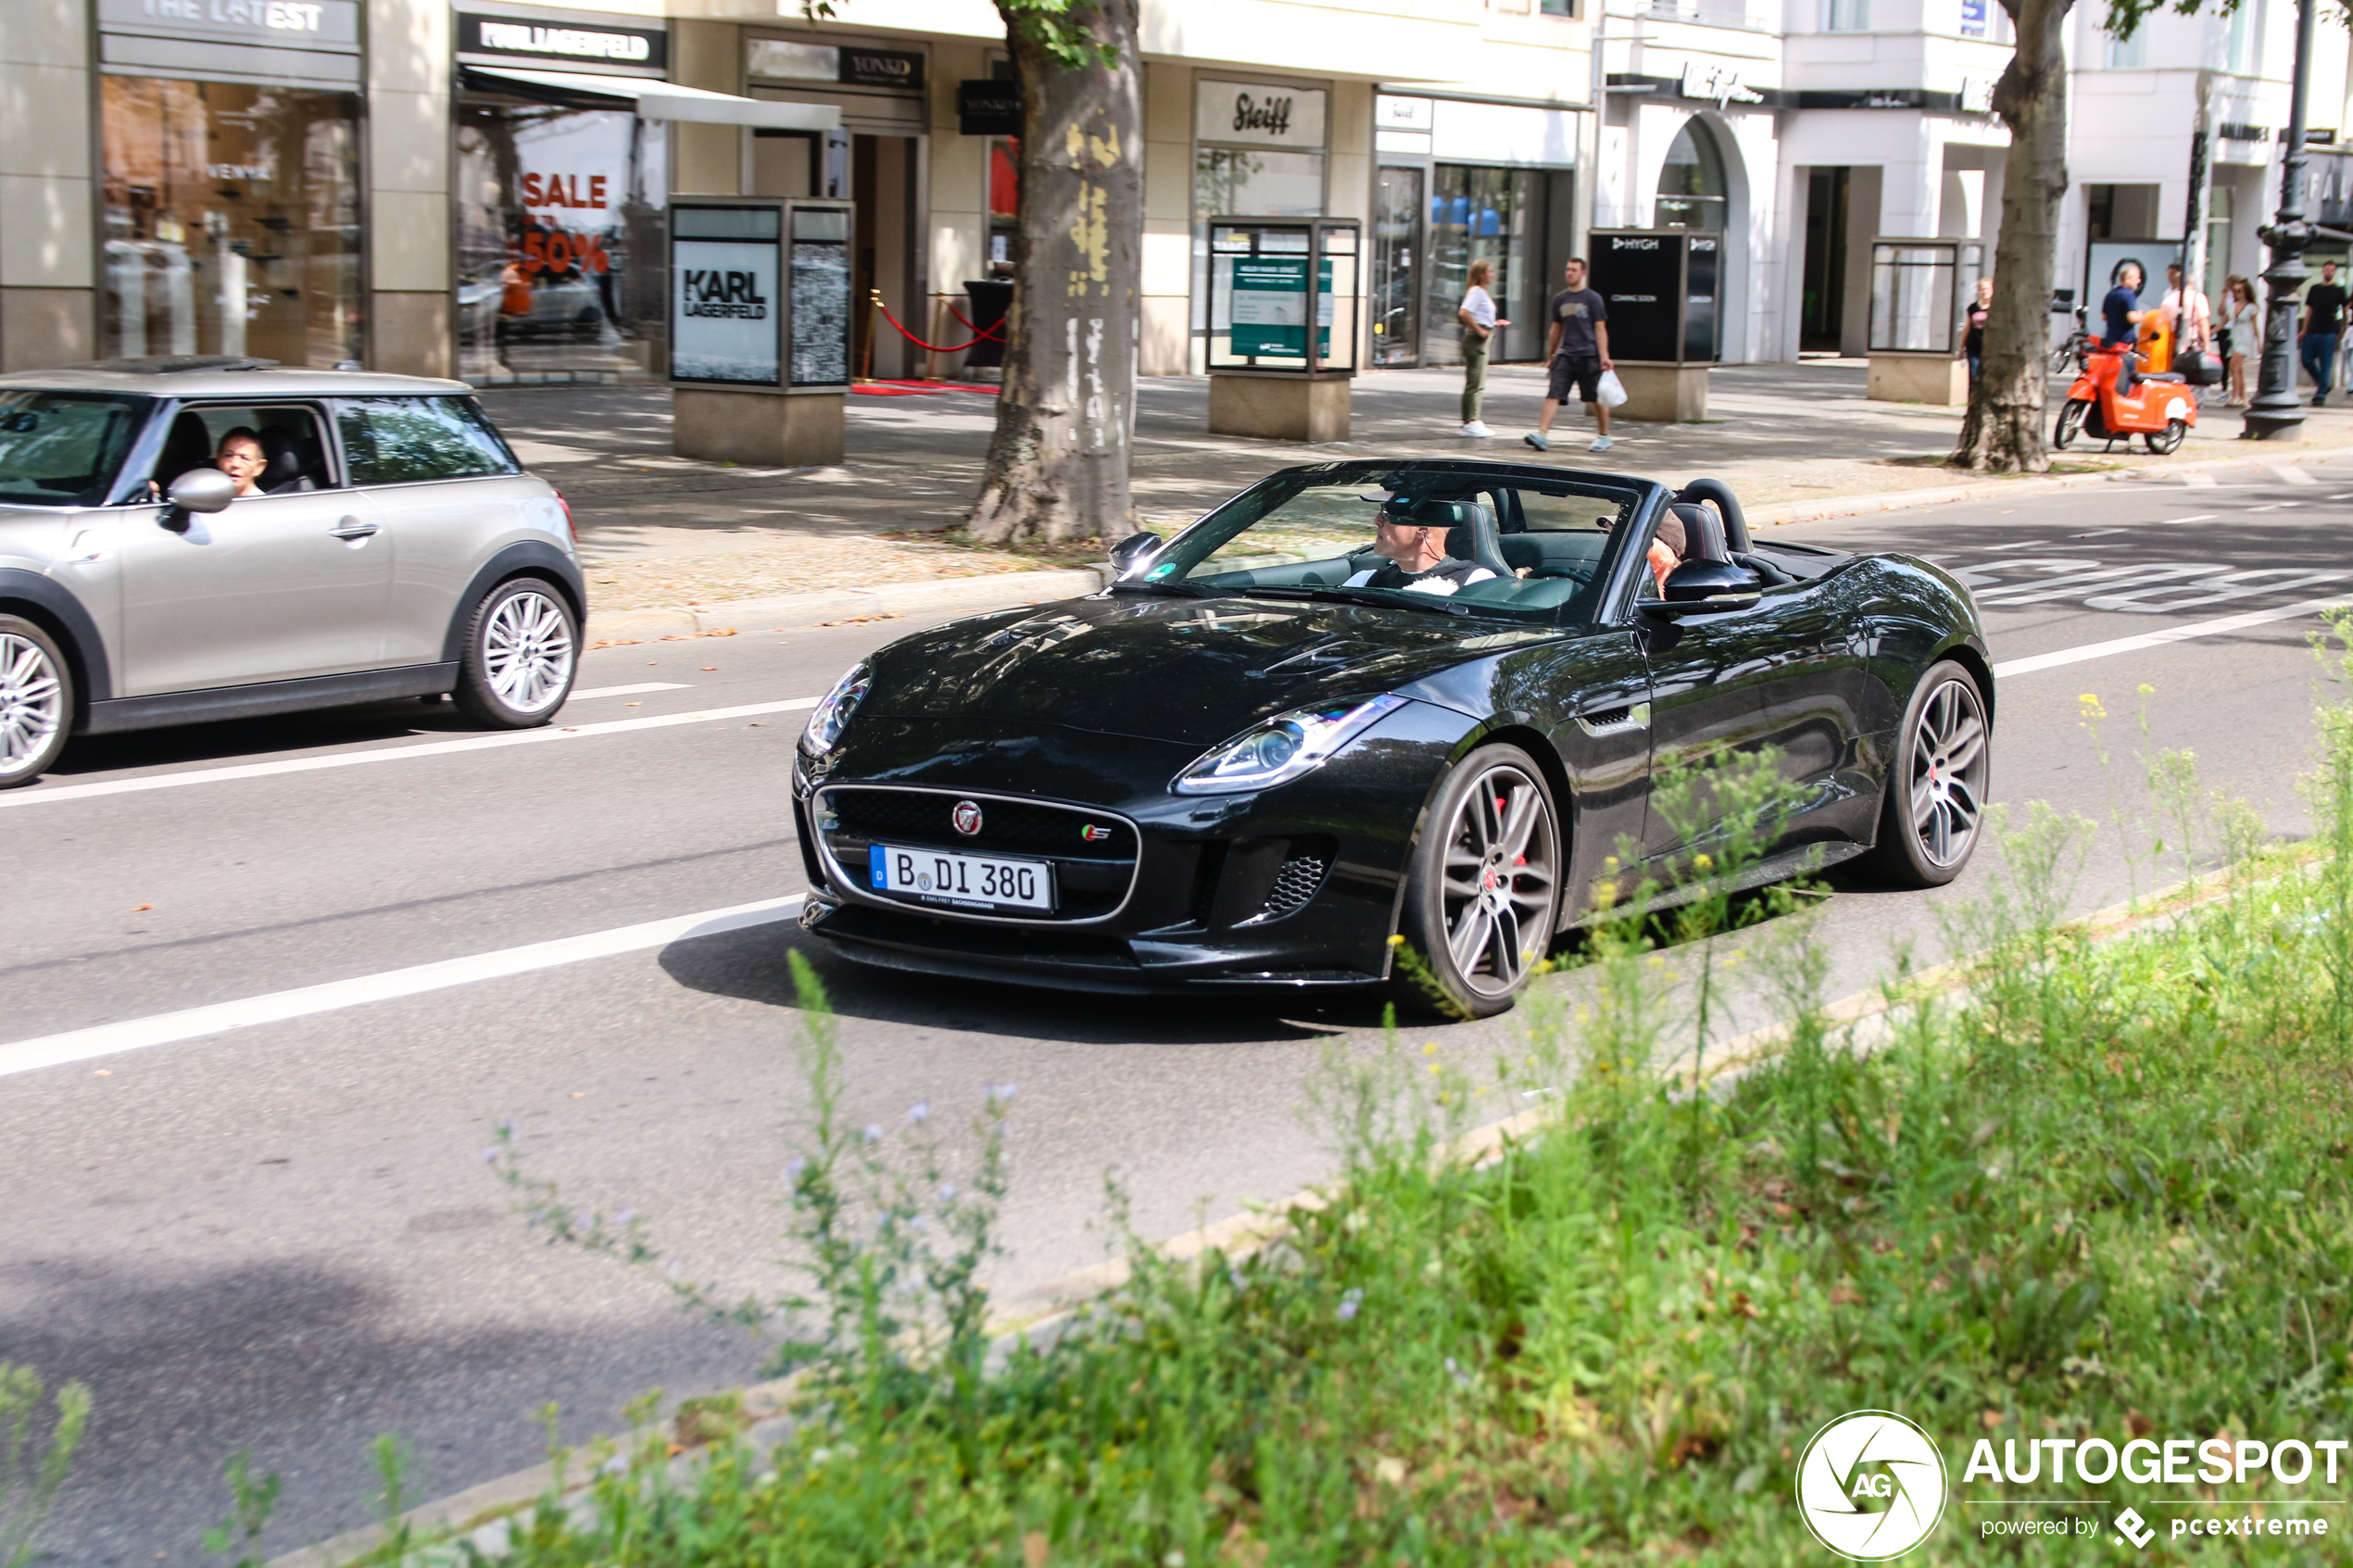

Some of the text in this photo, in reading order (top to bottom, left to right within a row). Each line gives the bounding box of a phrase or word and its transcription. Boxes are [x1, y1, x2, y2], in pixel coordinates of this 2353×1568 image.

[210, 0, 323, 31] LATEST
[1233, 93, 1292, 135] Steiff
[522, 172, 608, 209] SALE
[523, 232, 609, 273] 50%
[1624, 238, 1659, 250] HYGH
[684, 270, 767, 304] KARL
[684, 303, 768, 320] LAGERFELD
[876, 870, 884, 881] D
[897, 853, 1036, 901] B DI 380
